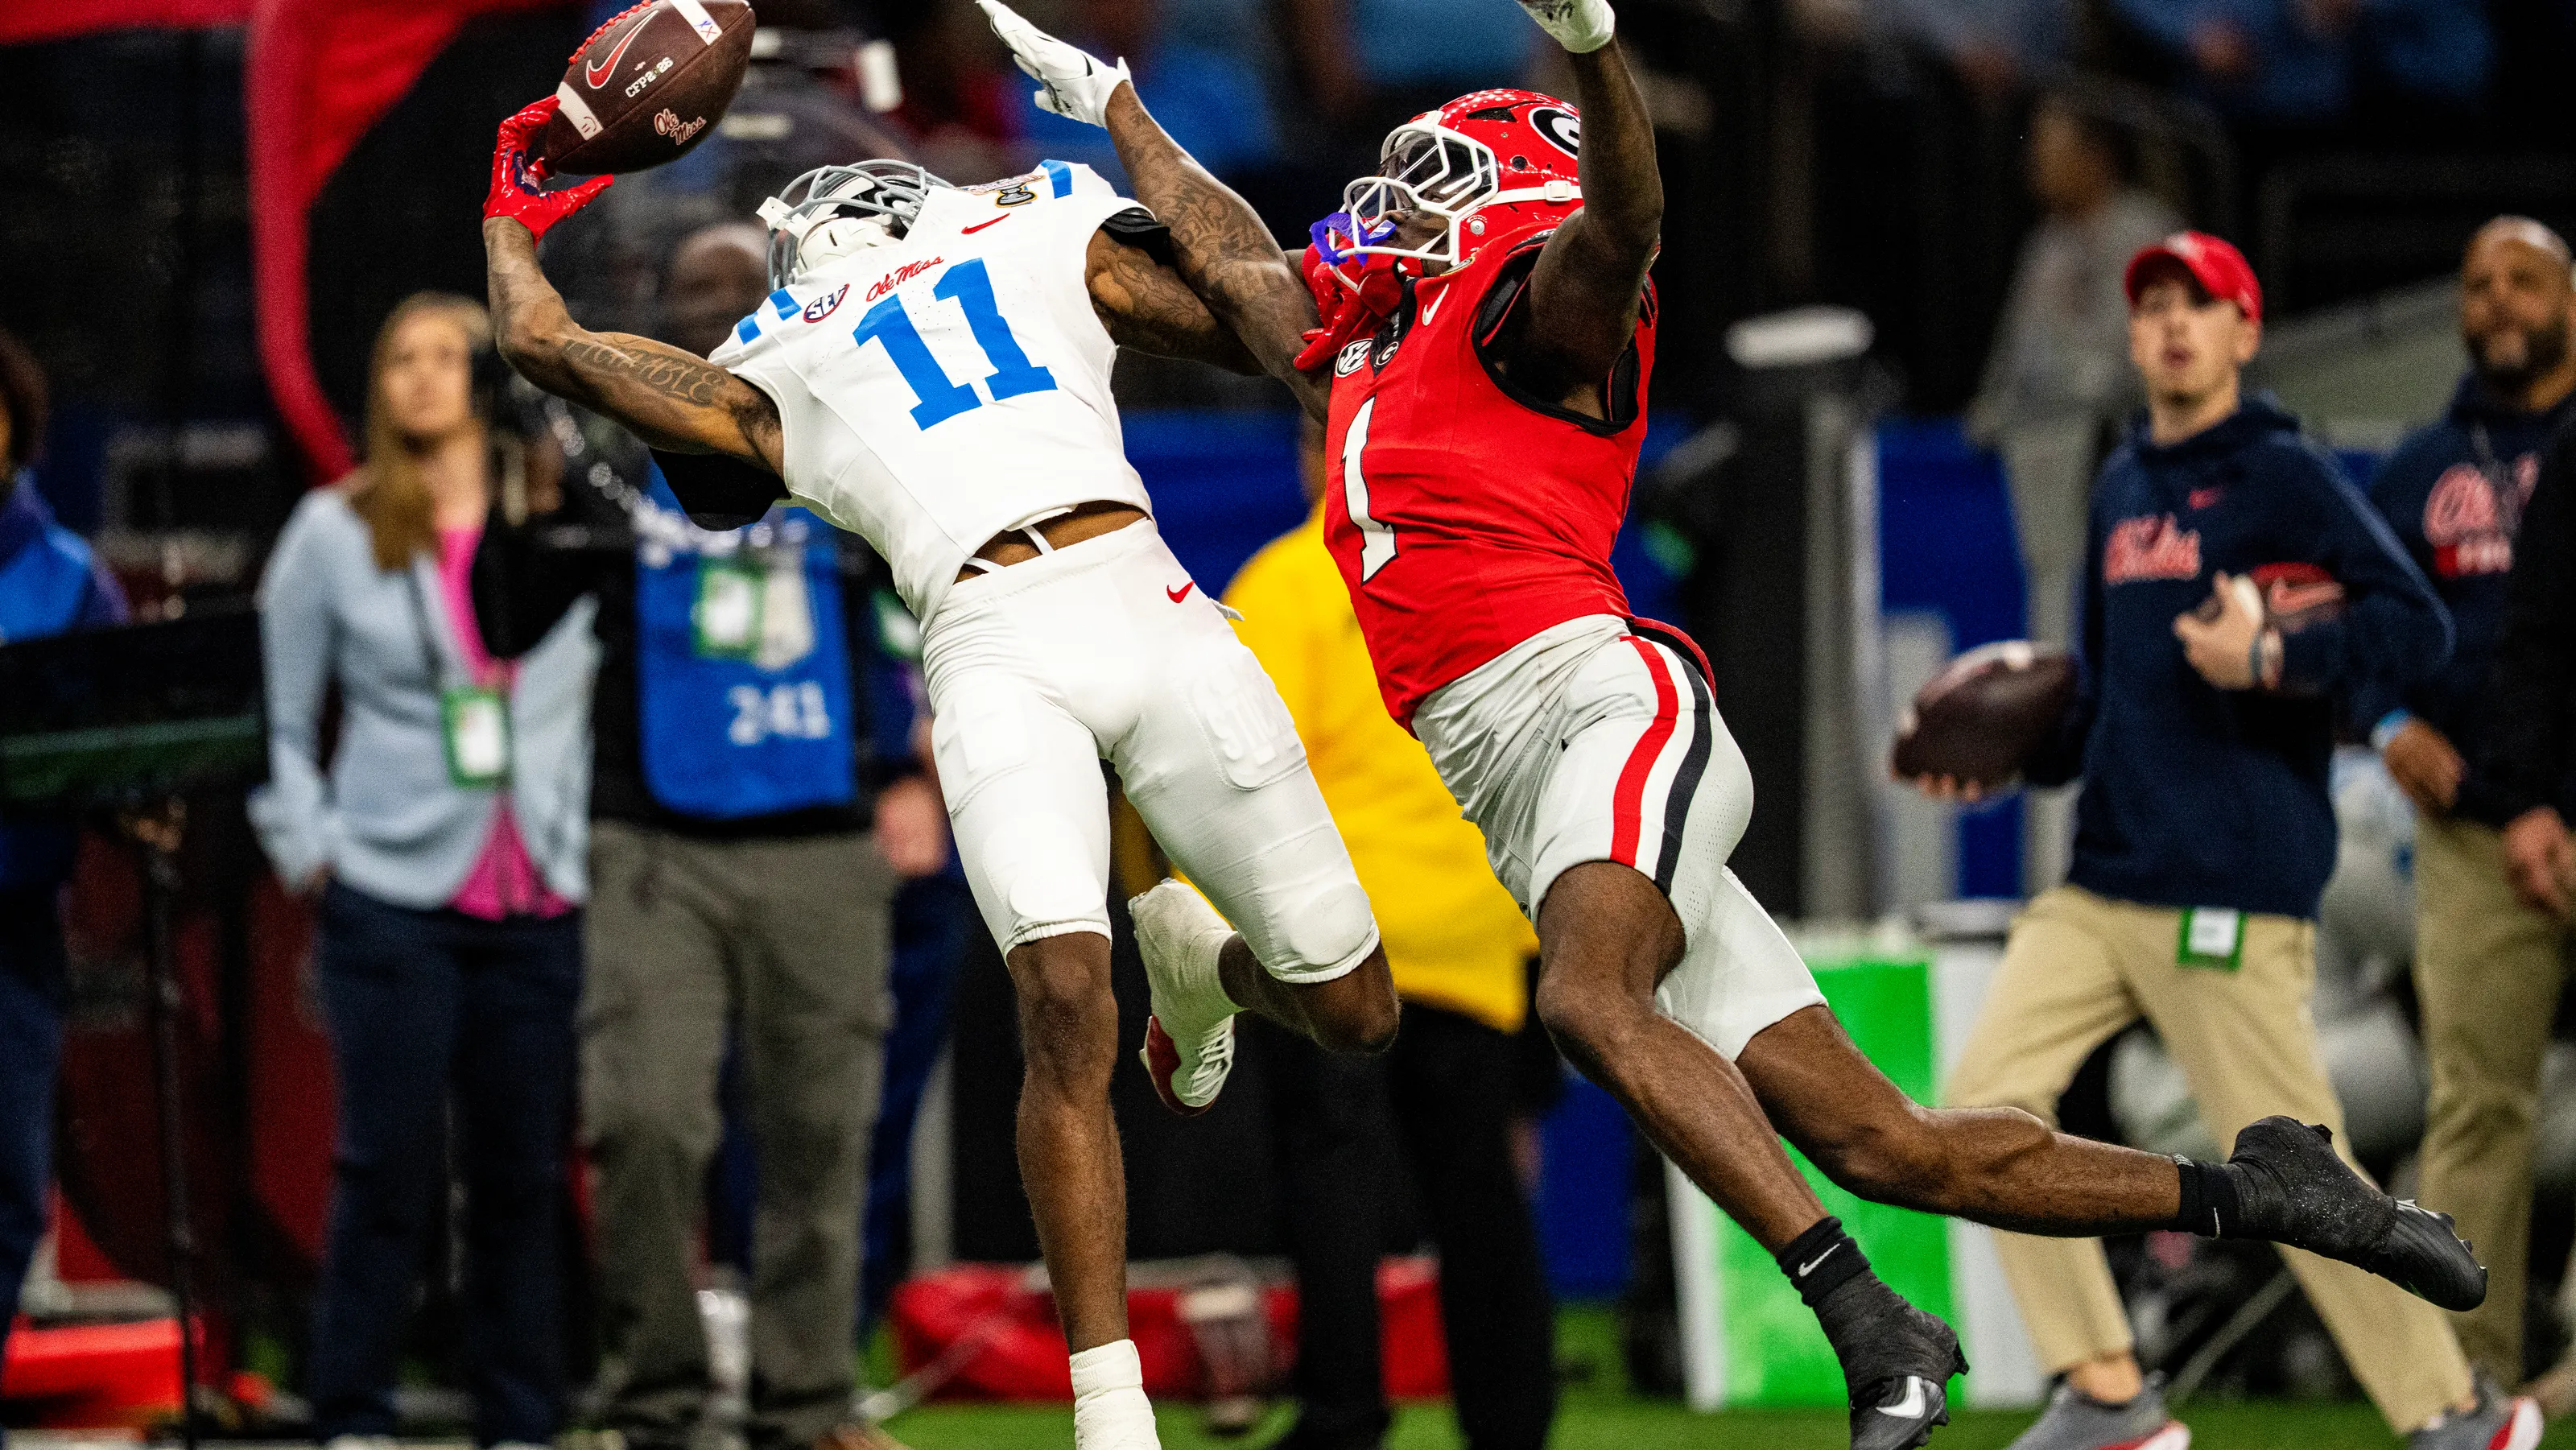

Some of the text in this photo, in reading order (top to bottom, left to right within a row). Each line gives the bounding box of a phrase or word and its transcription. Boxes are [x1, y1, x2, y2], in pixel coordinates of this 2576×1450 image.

[654, 109, 679, 135] Ole
[670, 116, 707, 146] Miss
[865, 256, 944, 302] Ole Miss
[852, 258, 1058, 431] 11
[1340, 393, 1399, 586] 1
[728, 681, 832, 746] 241
